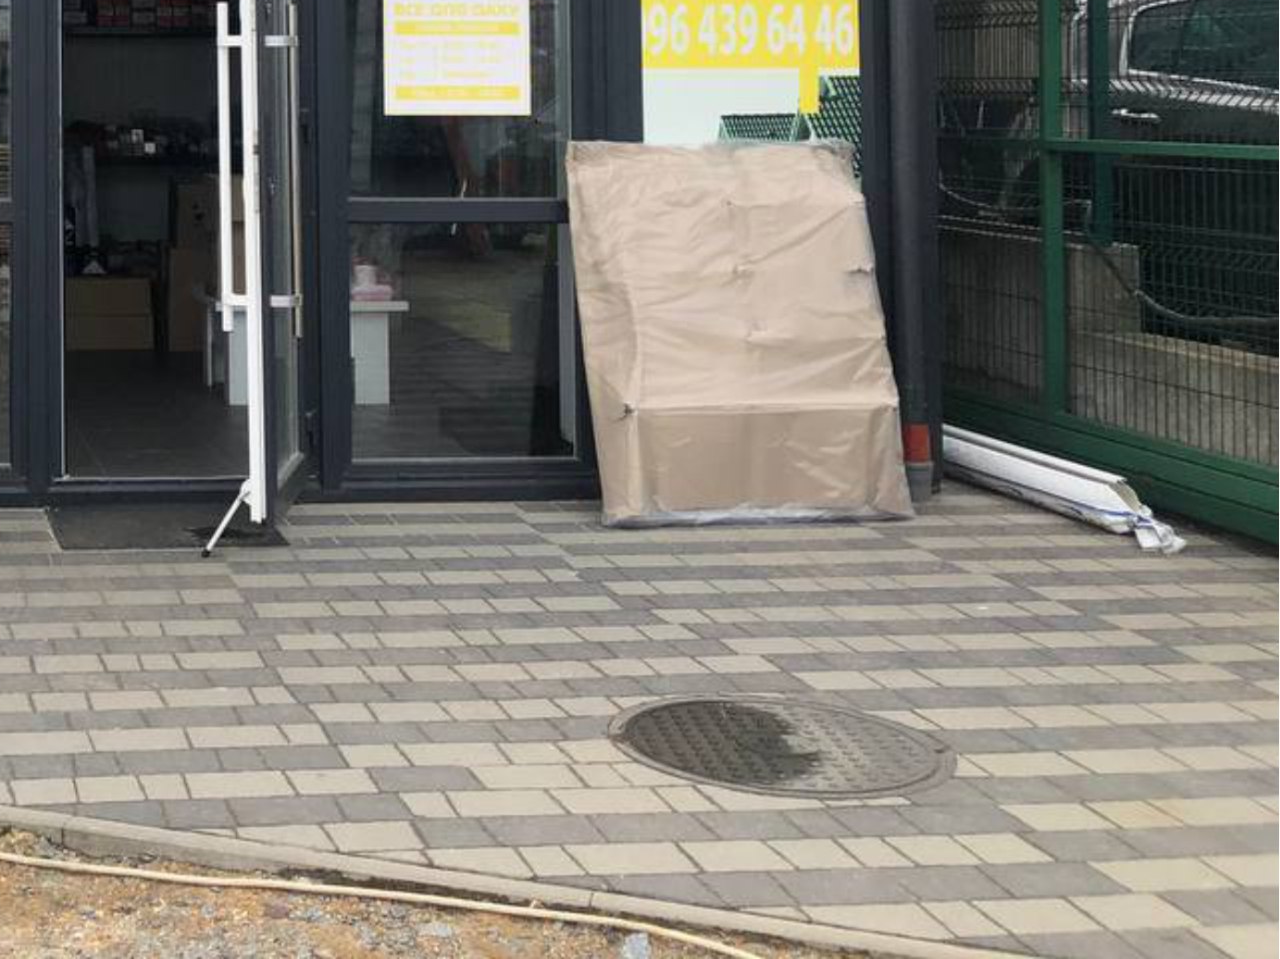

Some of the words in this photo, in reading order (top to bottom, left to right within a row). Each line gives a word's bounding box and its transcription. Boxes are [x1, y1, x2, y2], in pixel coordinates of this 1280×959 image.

[697, 3, 759, 57] 439
[766, 4, 806, 57] 64
[814, 4, 855, 57] 46
